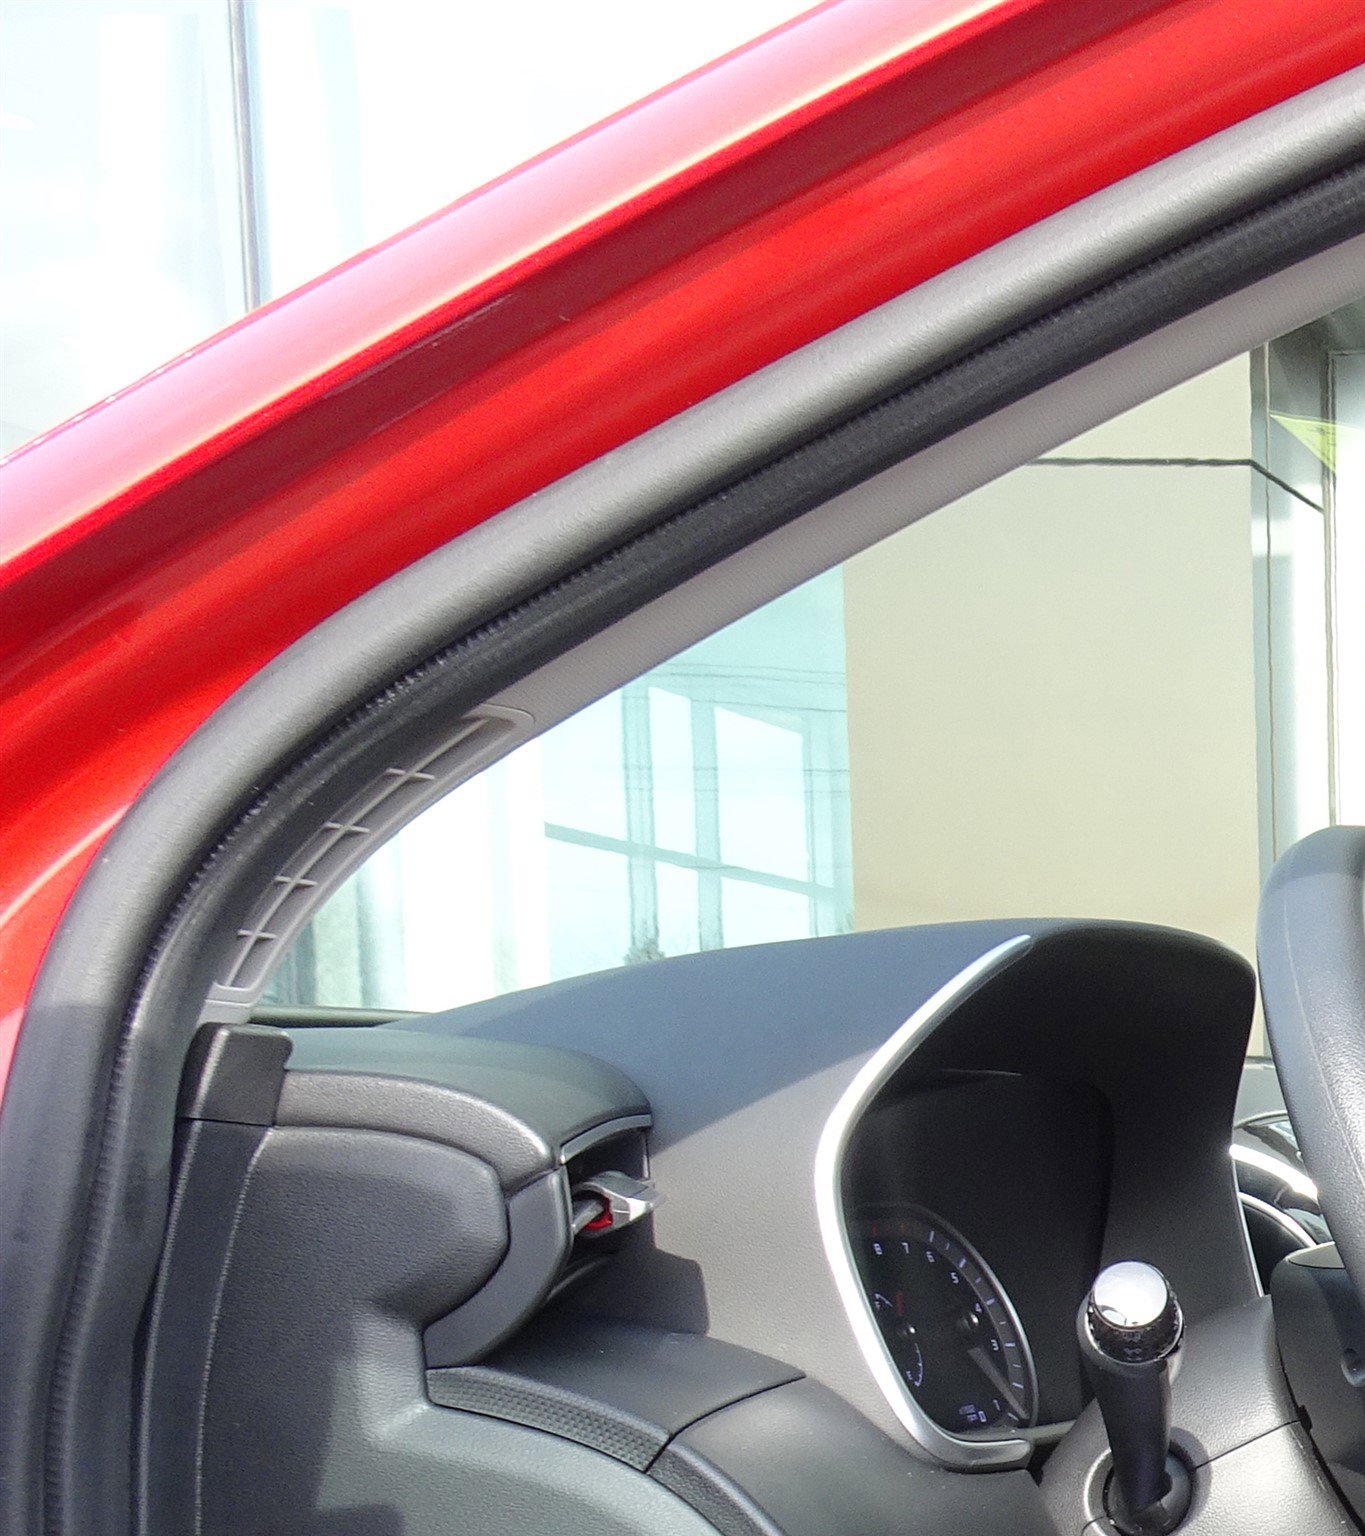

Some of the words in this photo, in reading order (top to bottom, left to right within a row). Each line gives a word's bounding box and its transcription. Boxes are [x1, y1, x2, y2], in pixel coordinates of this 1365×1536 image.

[872, 1242, 883, 1255] 8
[901, 1242, 910, 1254] 7
[926, 1250, 935, 1263] 6
[950, 1272, 959, 1284] 5
[990, 1339, 999, 1351] 3
